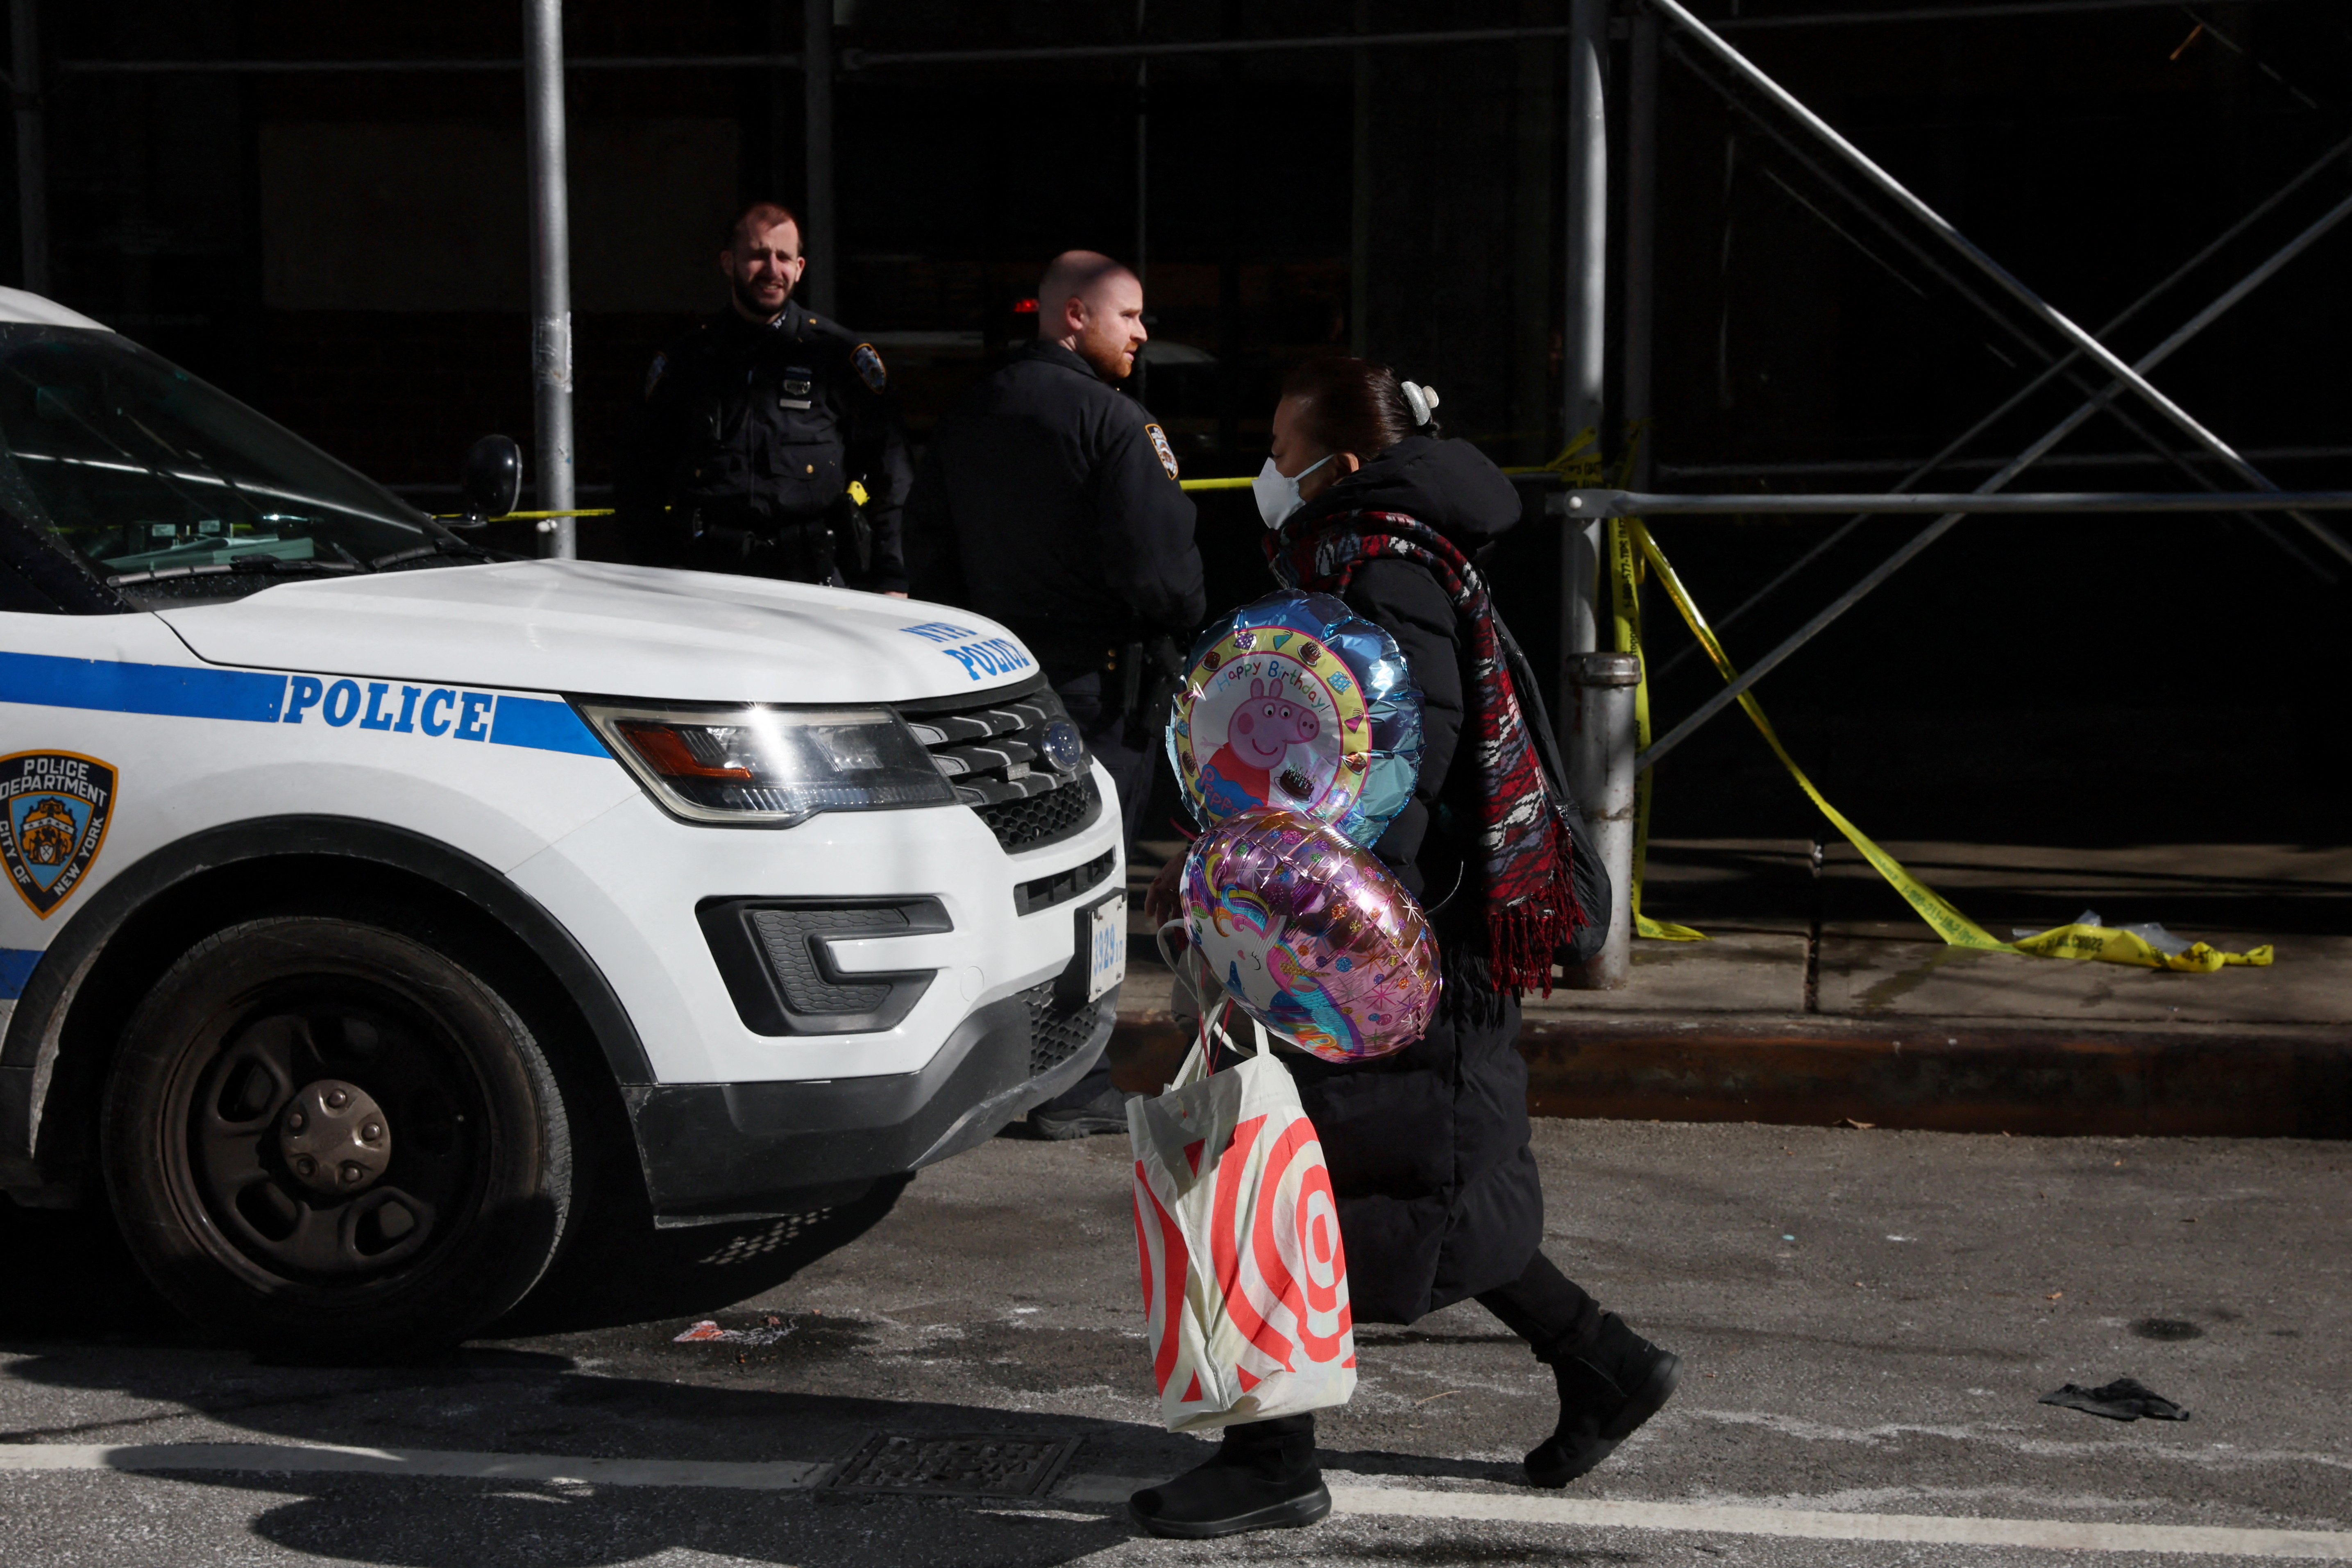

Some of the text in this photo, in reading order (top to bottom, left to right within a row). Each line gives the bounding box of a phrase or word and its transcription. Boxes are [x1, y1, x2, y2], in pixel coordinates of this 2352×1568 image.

[941, 638, 1030, 681] POLICE
[283, 675, 493, 742] POLICE
[1216, 660, 1330, 713] Happy Birthday!
[0, 774, 107, 808] DEPARTMENT
[23, 758, 90, 781] POLICE
[0, 820, 31, 884] CITY OF
[53, 817, 104, 896] NEW YORK
[1094, 923, 1115, 977] 3929
